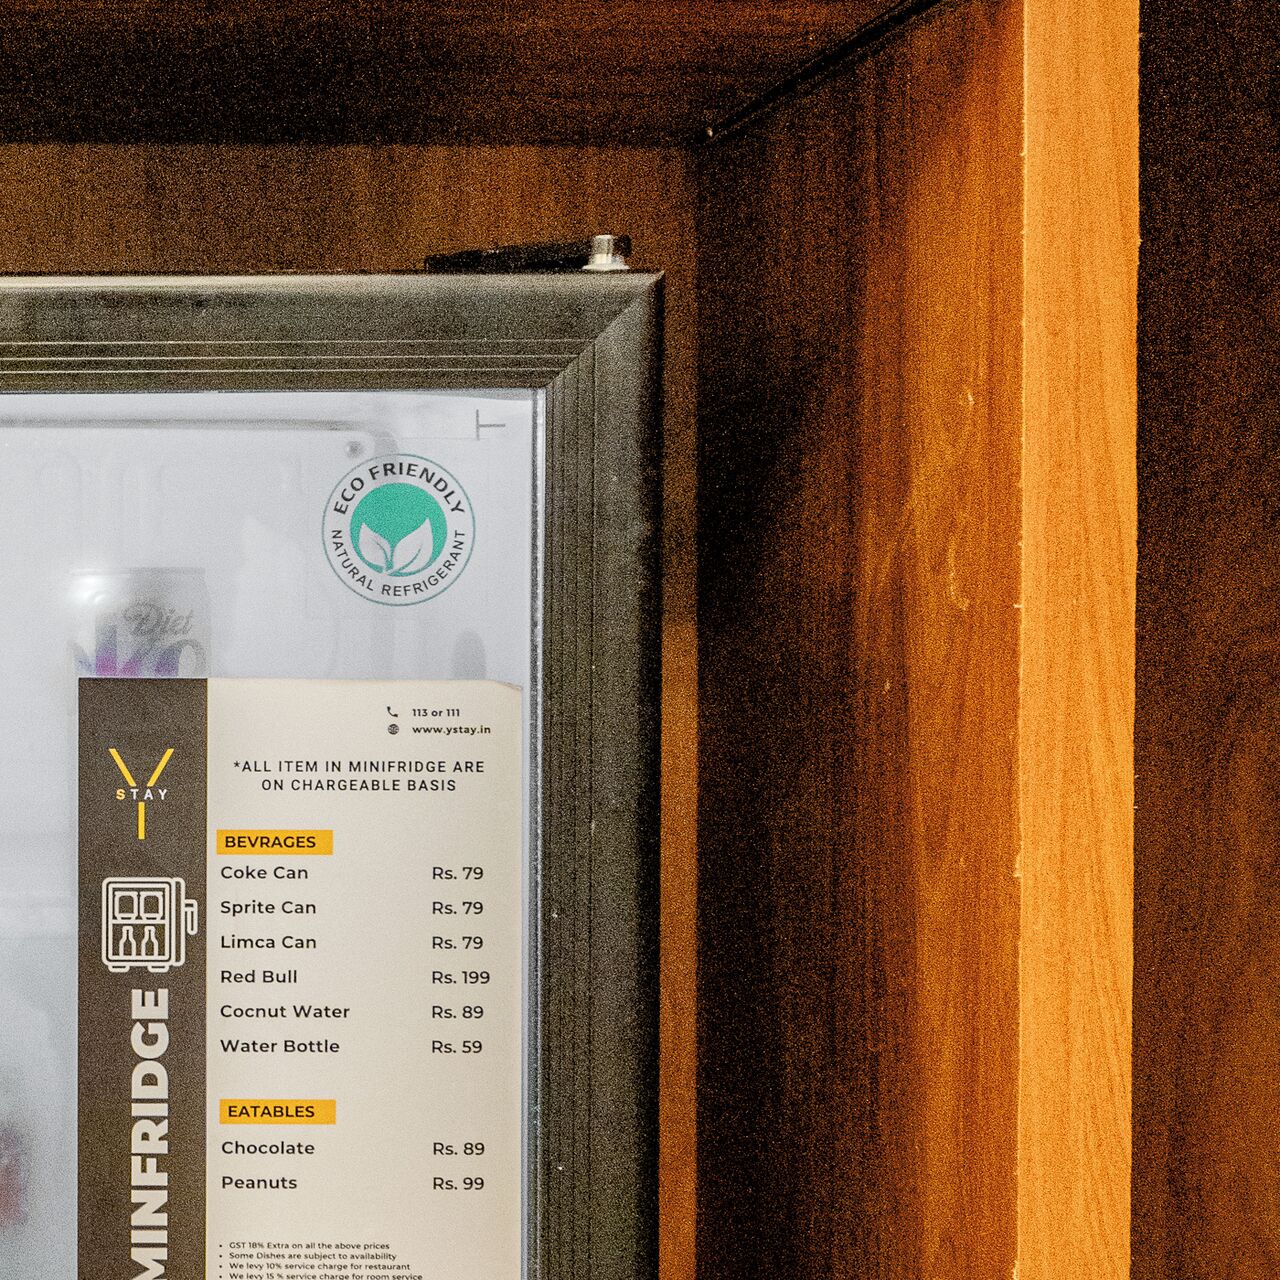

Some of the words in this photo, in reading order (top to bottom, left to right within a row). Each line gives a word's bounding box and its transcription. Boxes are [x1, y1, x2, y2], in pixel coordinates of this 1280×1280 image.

[333, 477, 365, 515] ECO
[368, 462, 466, 515] FRIENDLY
[331, 529, 374, 592] NATURAL
[381, 530, 466, 597] REFRIGERANT
[412, 708, 428, 717] 113
[446, 708, 460, 717] 111
[412, 725, 491, 736] www.ystay.in
[278, 760, 318, 773] ITEM
[325, 760, 342, 773] IN
[348, 760, 447, 773] MINIFRIDGE
[452, 761, 485, 773] ARE
[261, 778, 284, 791] ON
[290, 778, 401, 792] CHARGEABLE
[407, 779, 457, 792] BASIS
[115, 788, 167, 801] STAY
[225, 835, 317, 849] BEVRAGES
[220, 865, 267, 880] Coke
[273, 865, 309, 880] Can
[432, 866, 457, 881] Rs.
[462, 866, 484, 881] 79
[220, 900, 276, 918] Sprite
[281, 900, 317, 914] Can
[432, 901, 457, 915] Rs.
[462, 901, 484, 915] 79
[220, 934, 276, 949] Limca
[281, 934, 317, 949] Can
[431, 935, 457, 950] Rs.
[462, 935, 484, 950] 79
[220, 969, 256, 984] Red
[262, 969, 298, 984] Bull
[431, 970, 457, 985] Rs.
[461, 970, 491, 985] 199
[220, 1004, 287, 1019] Cocnut
[292, 1004, 351, 1019] Water
[431, 1005, 457, 1020] Rs.
[461, 1005, 485, 1020] 89
[220, 1039, 278, 1053] Water
[283, 1039, 341, 1053] Bottle
[431, 1040, 457, 1054] Rs.
[461, 1040, 483, 1054] 59
[228, 1105, 315, 1118] EATABLES
[221, 1140, 316, 1155] Chocolate
[432, 1141, 459, 1156] Rs.
[463, 1141, 486, 1156] 89
[221, 1175, 298, 1190] Peanuts
[432, 1176, 458, 1191] Rs.
[462, 1176, 485, 1191] 99
[363, 1242, 390, 1251] prices
[304, 1252, 336, 1261] subject
[350, 1252, 397, 1261] availability
[246, 1262, 264, 1271] levy
[317, 1262, 348, 1271] charge
